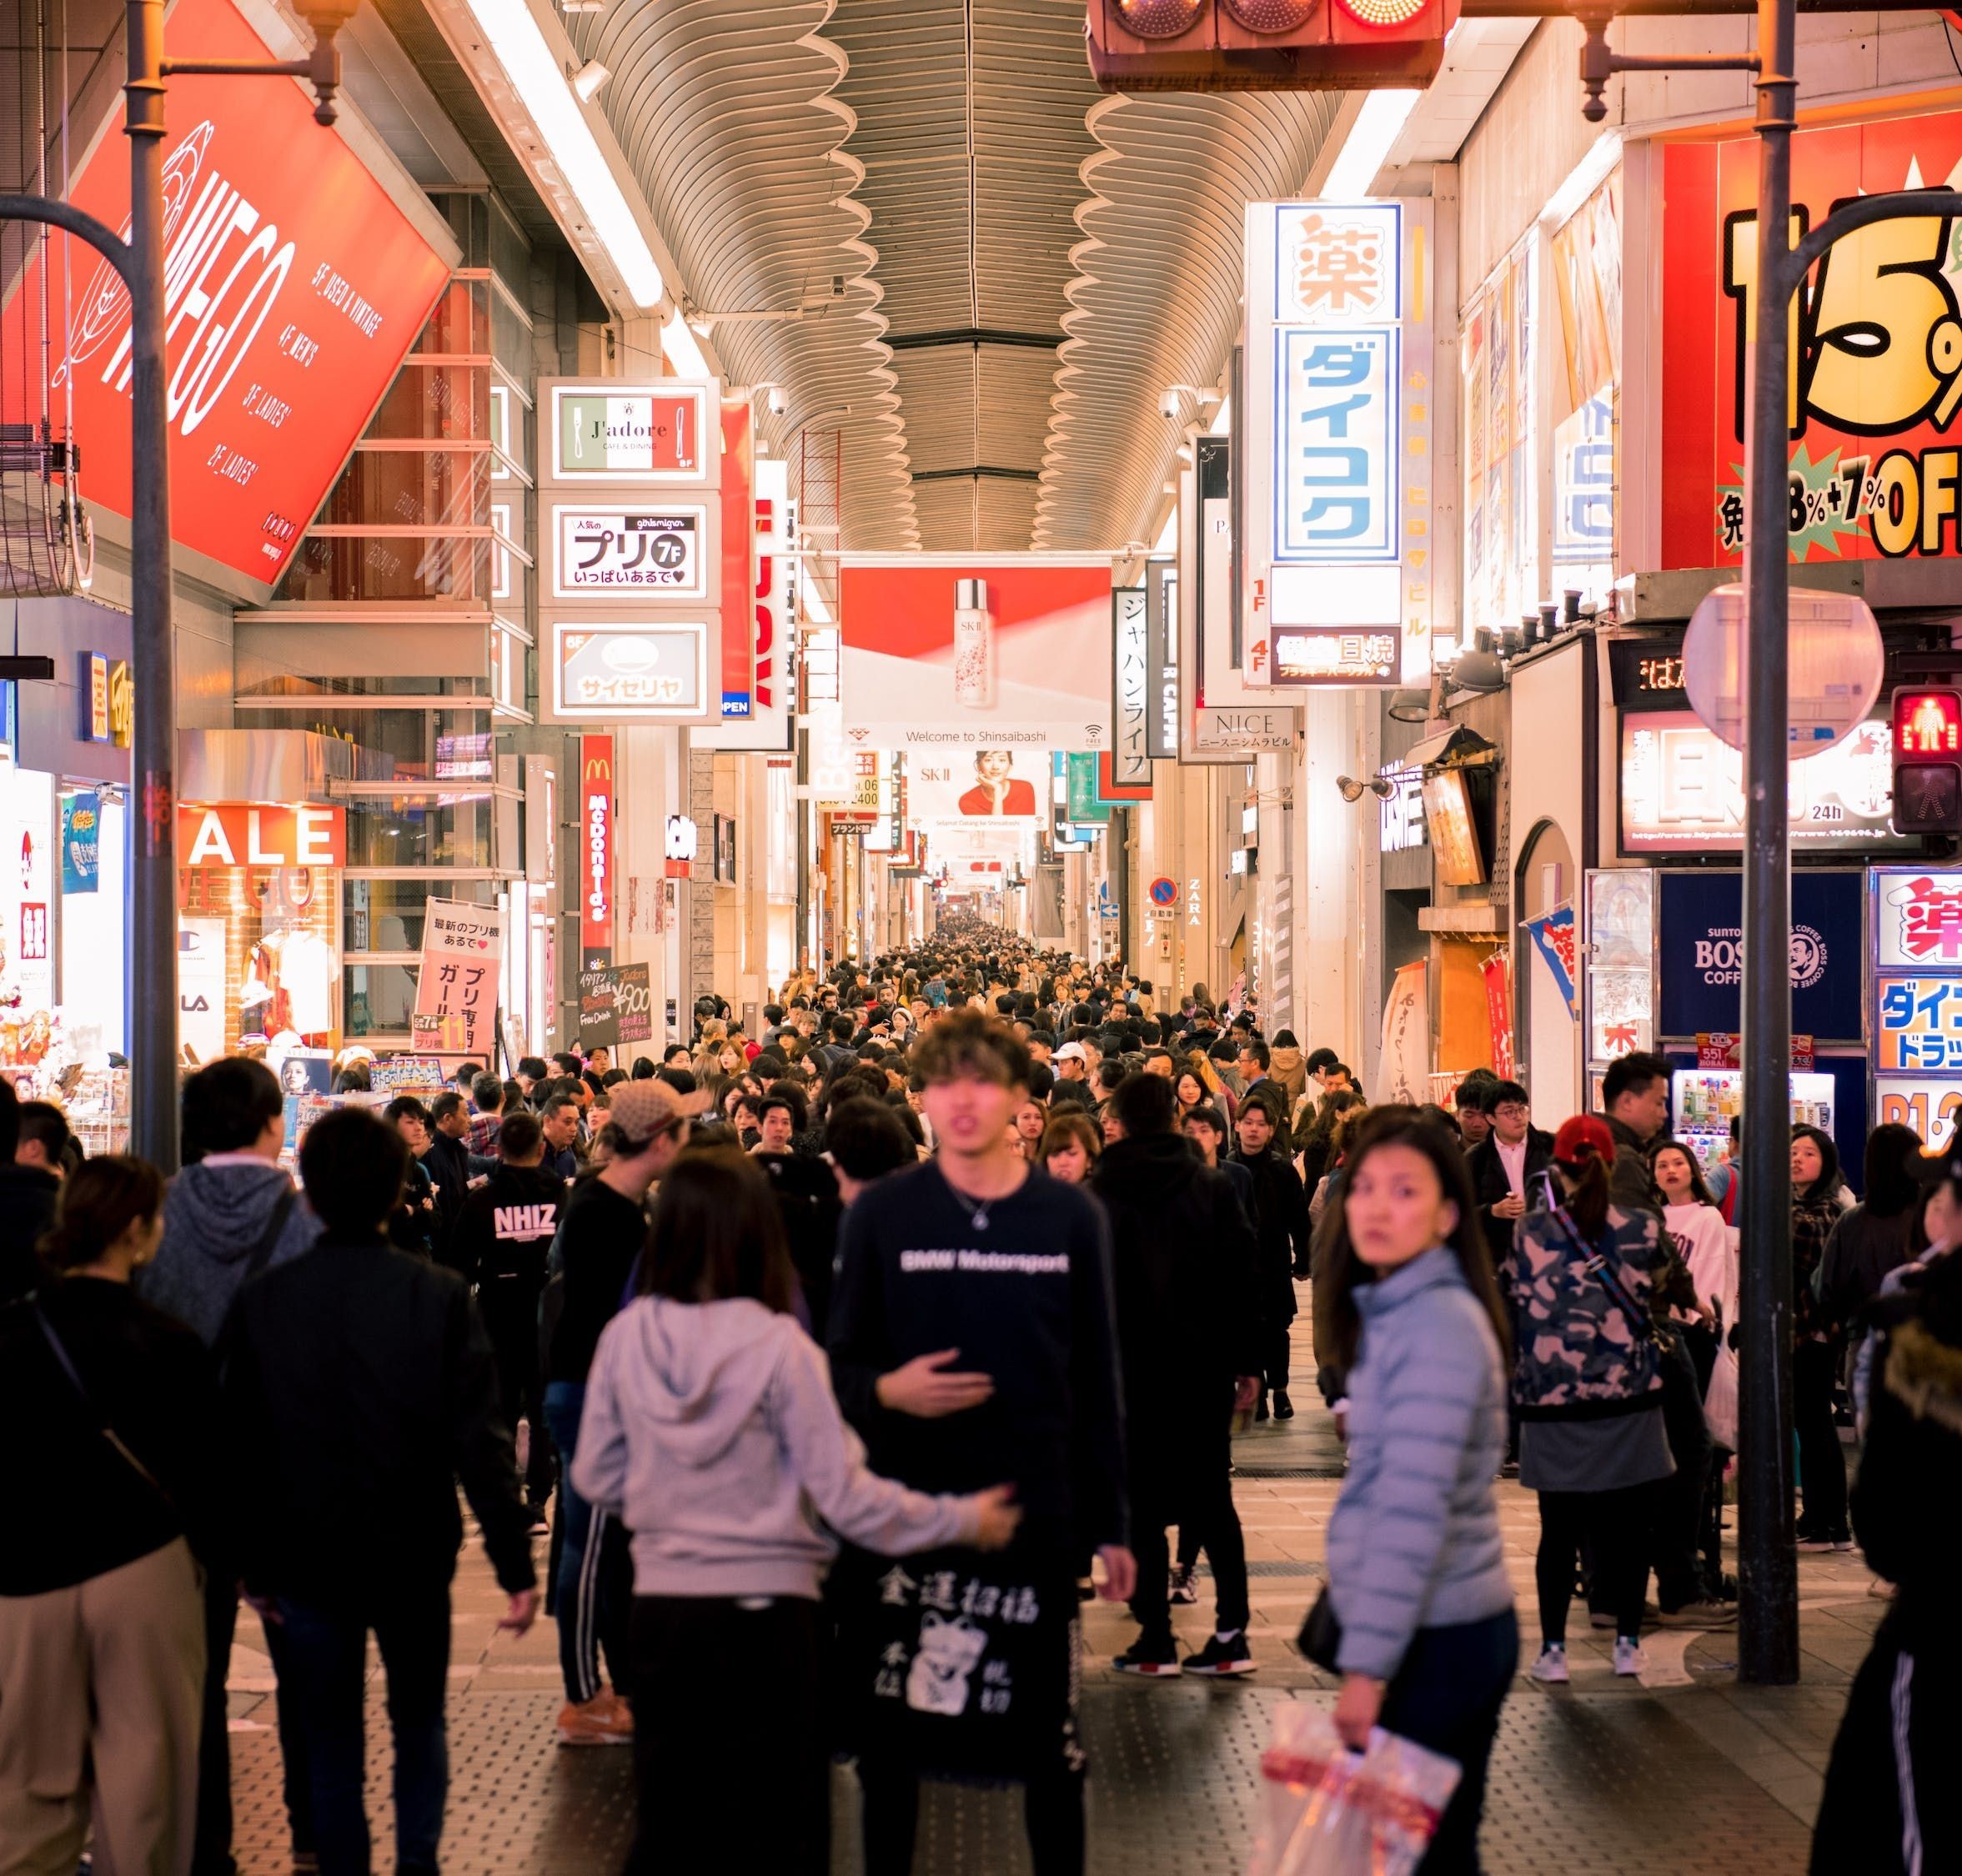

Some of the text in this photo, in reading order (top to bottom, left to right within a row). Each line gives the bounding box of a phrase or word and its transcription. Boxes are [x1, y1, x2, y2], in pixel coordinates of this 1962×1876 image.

[1299, 213, 1379, 309] 薬
[101, 169, 295, 437] WEGO
[349, 295, 383, 339] VINTAGE
[591, 420, 668, 439] J'adore
[1301, 341, 1376, 540] ダイコク
[577, 519, 601, 529] 人気の
[575, 529, 681, 569] プリ 7F
[574, 569, 672, 584] いっぱいあるで
[1252, 579, 1266, 612] 1F
[1251, 640, 1268, 672] 4F
[1123, 596, 1147, 776] ジャハンライフ
[720, 701, 748, 713] PEN
[906, 730, 1046, 742] Welcome to Shinsaibashi
[1217, 715, 1275, 734] NICE
[1200, 736, 1292, 748] ニースニシムラビル
[865, 780, 878, 791] 06
[1813, 805, 1841, 820] 24h
[188, 810, 334, 865] ALE
[588, 795, 608, 922] McDonald's
[1188, 879, 1202, 925] ZARA
[434, 917, 500, 938] 最新のプリ機
[1795, 924, 1823, 941] COFFEE
[444, 934, 477, 949] あるで
[1819, 943, 1828, 966] BOSS
[1704, 971, 1741, 985] COFF
[1800, 966, 1825, 989] COFFEE
[180, 995, 209, 1011] LA
[611, 981, 651, 1016] ¥900
[439, 1016, 464, 1050] 11
[1702, 1048, 1722, 1060] 551
[494, 1204, 556, 1232] NHIZ
[901, 1249, 1070, 1276] BMW Motorsport
